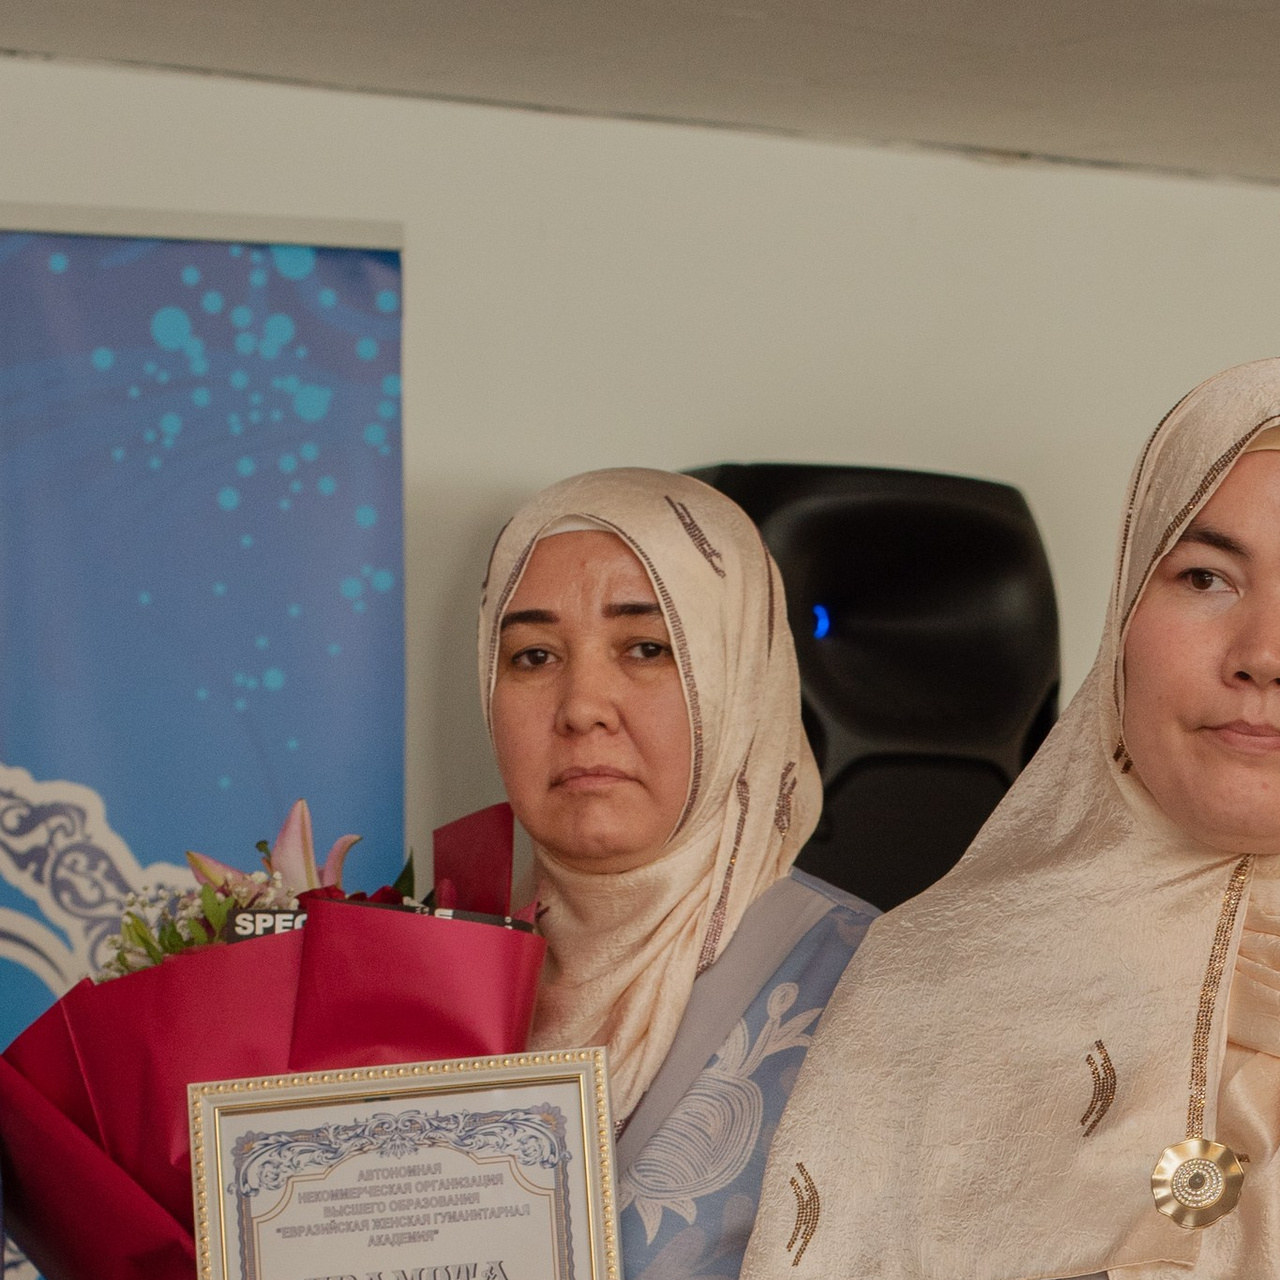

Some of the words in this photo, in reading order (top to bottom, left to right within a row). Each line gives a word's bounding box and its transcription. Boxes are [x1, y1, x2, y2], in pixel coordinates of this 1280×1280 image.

[358, 1163, 442, 1182] АВТОНОМНАЯ
[414, 1173, 504, 1194] ОРГАНИЗАЦИЯ
[323, 1203, 386, 1218] ВЫСШЕГО
[389, 1192, 480, 1212] ОБРАЗОВАНИЯ
[371, 1213, 431, 1230] ЖЕНСКАЯ
[433, 1204, 530, 1225] ГУМАНИТАРНАЯ
